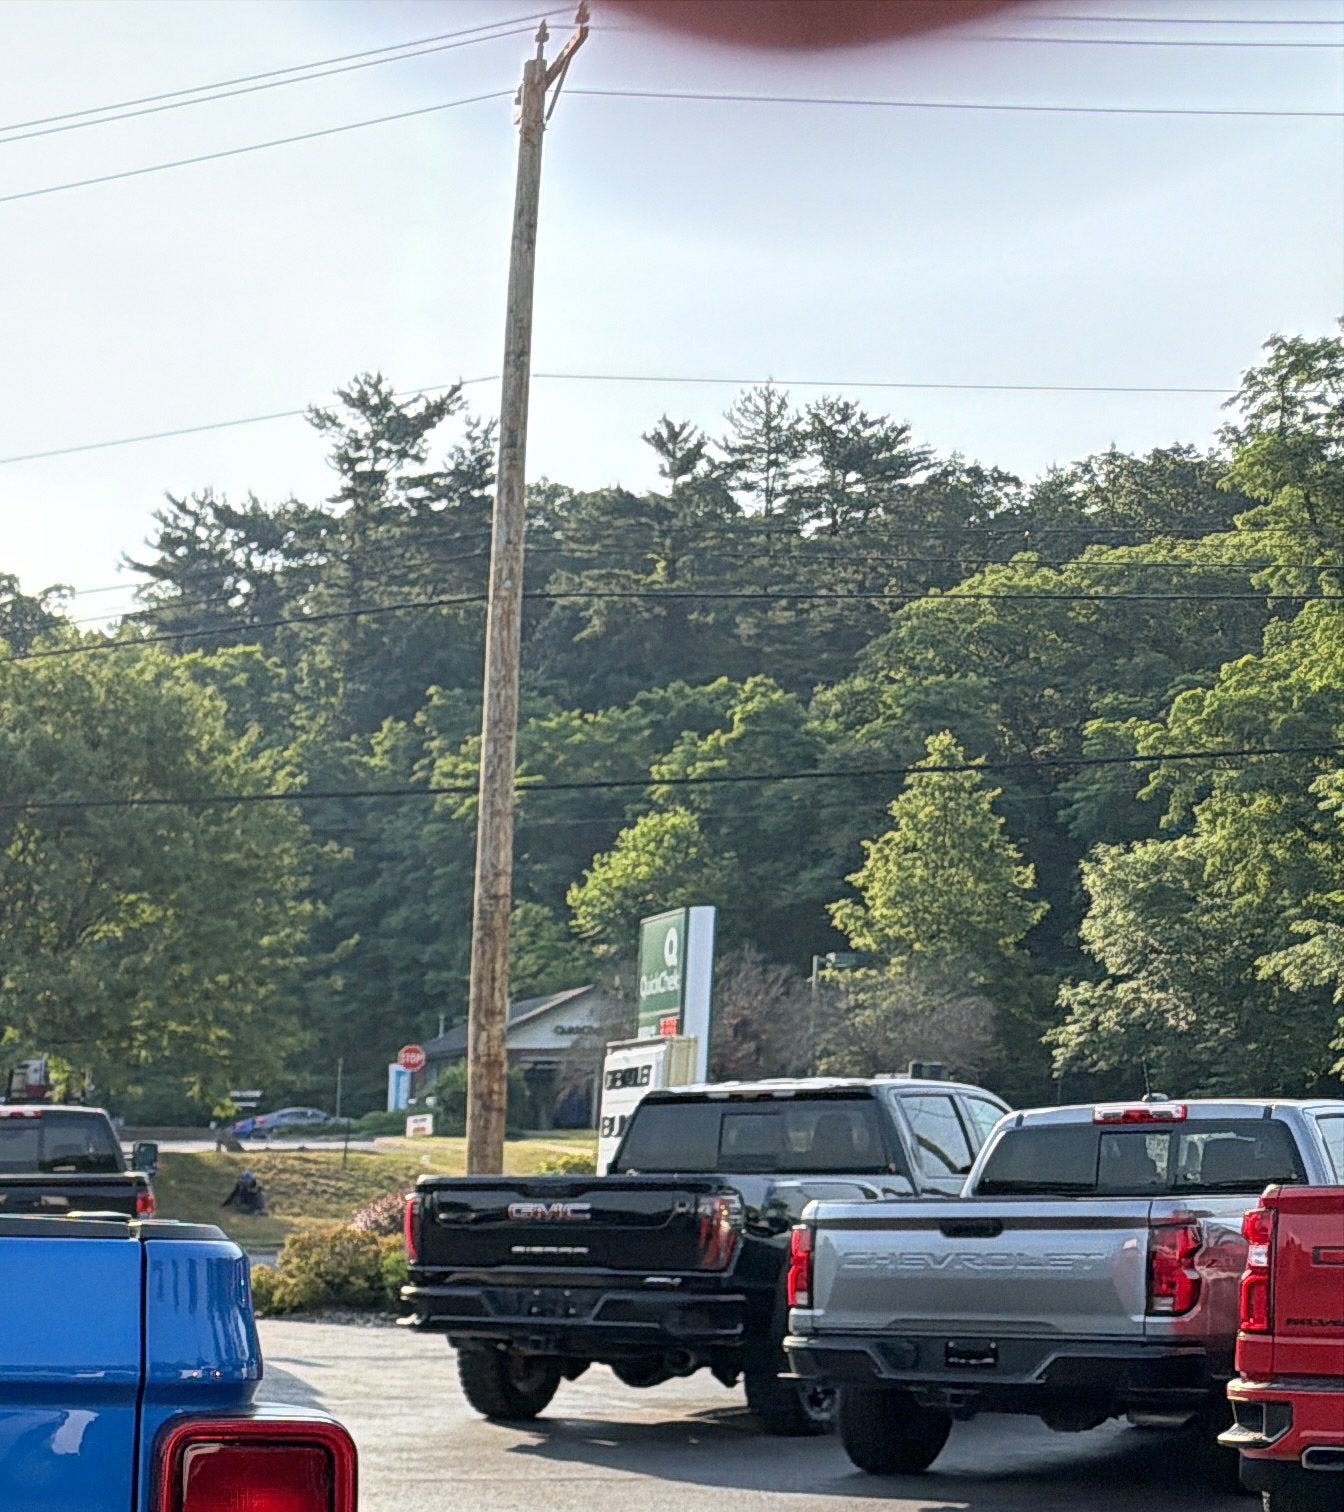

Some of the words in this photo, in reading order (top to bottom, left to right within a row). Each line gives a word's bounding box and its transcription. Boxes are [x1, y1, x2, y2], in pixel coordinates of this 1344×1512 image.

[664, 927, 678, 967] Q
[400, 1052, 424, 1064] STOP
[508, 1202, 592, 1220] GMC
[840, 1251, 1105, 1271] CHEVROLET
